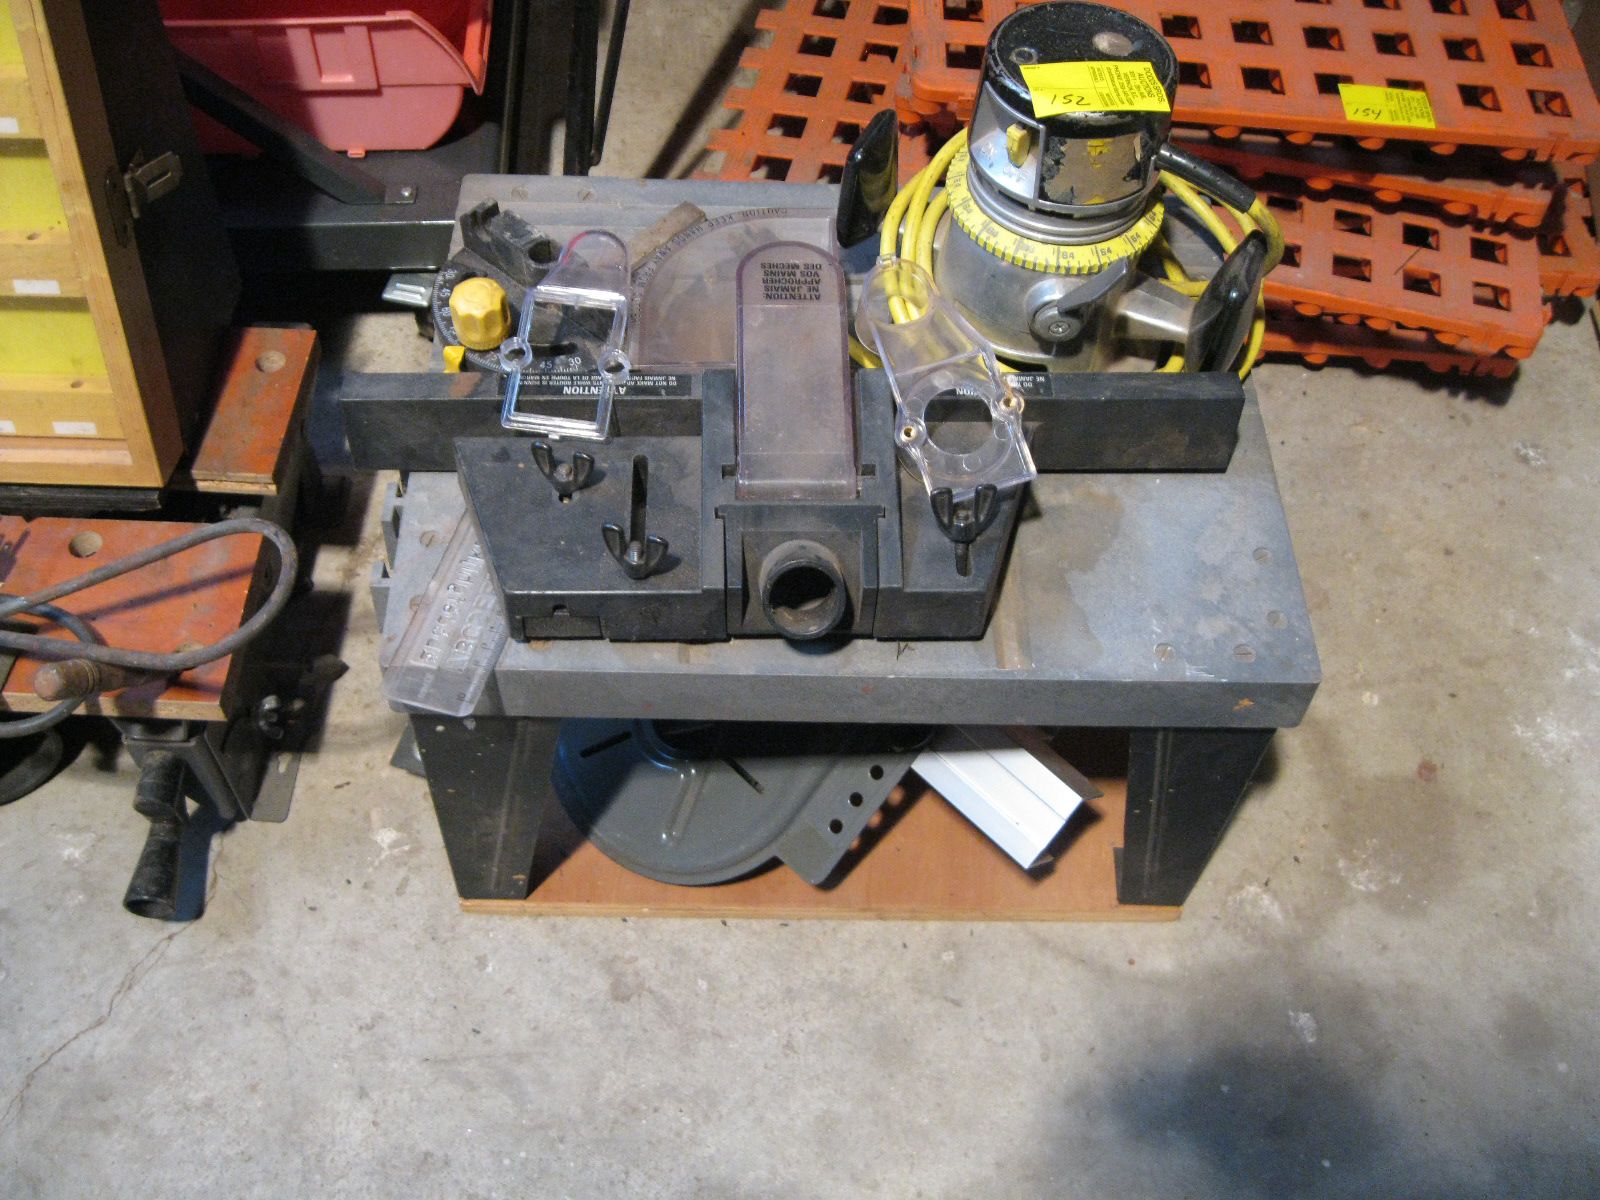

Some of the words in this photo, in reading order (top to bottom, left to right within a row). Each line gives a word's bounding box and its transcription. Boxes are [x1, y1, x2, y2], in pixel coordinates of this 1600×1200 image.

[1138, 72, 1155, 98] AUCTIONS
[1051, 94, 1091, 106] 152
[1353, 108, 1382, 120] 154
[540, 360, 553, 369] 45
[568, 356, 582, 366] 30
[563, 386, 626, 394] ATENTION
